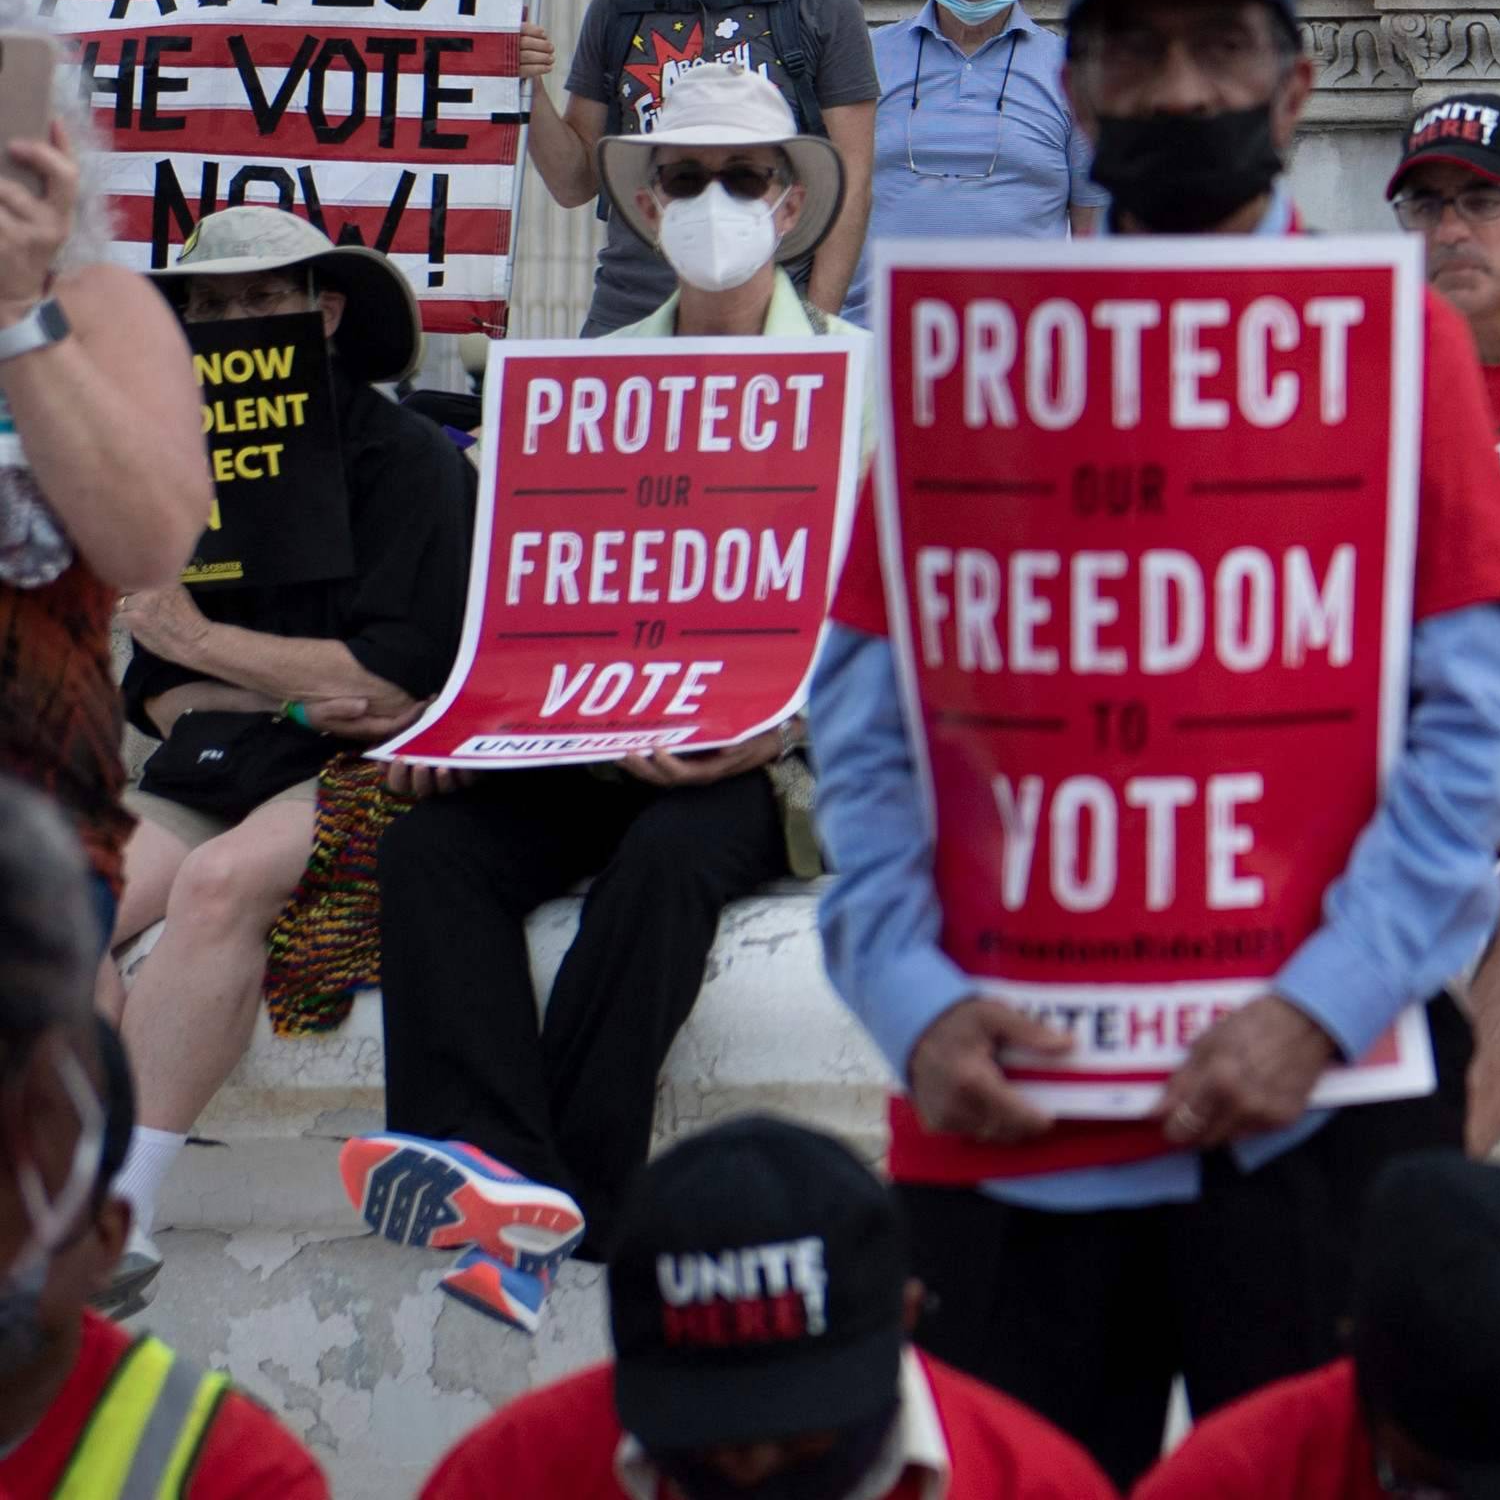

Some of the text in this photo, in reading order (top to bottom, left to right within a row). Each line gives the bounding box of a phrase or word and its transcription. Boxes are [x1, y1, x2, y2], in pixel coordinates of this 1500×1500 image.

[227, 34, 475, 151] VOTE
[1413, 102, 1500, 135] UNITE
[911, 294, 1366, 431] PROTECT
[522, 373, 823, 455] PROTECT
[210, 443, 285, 483] ECT
[635, 475, 692, 508] OUR
[1070, 463, 1168, 519] OUR
[506, 527, 809, 605] FREEDOM
[632, 619, 667, 650] TO
[913, 543, 1358, 675] FREEDOM
[538, 660, 725, 718] VOTE
[1091, 700, 1151, 758] TO
[991, 773, 1266, 913] VOTE
